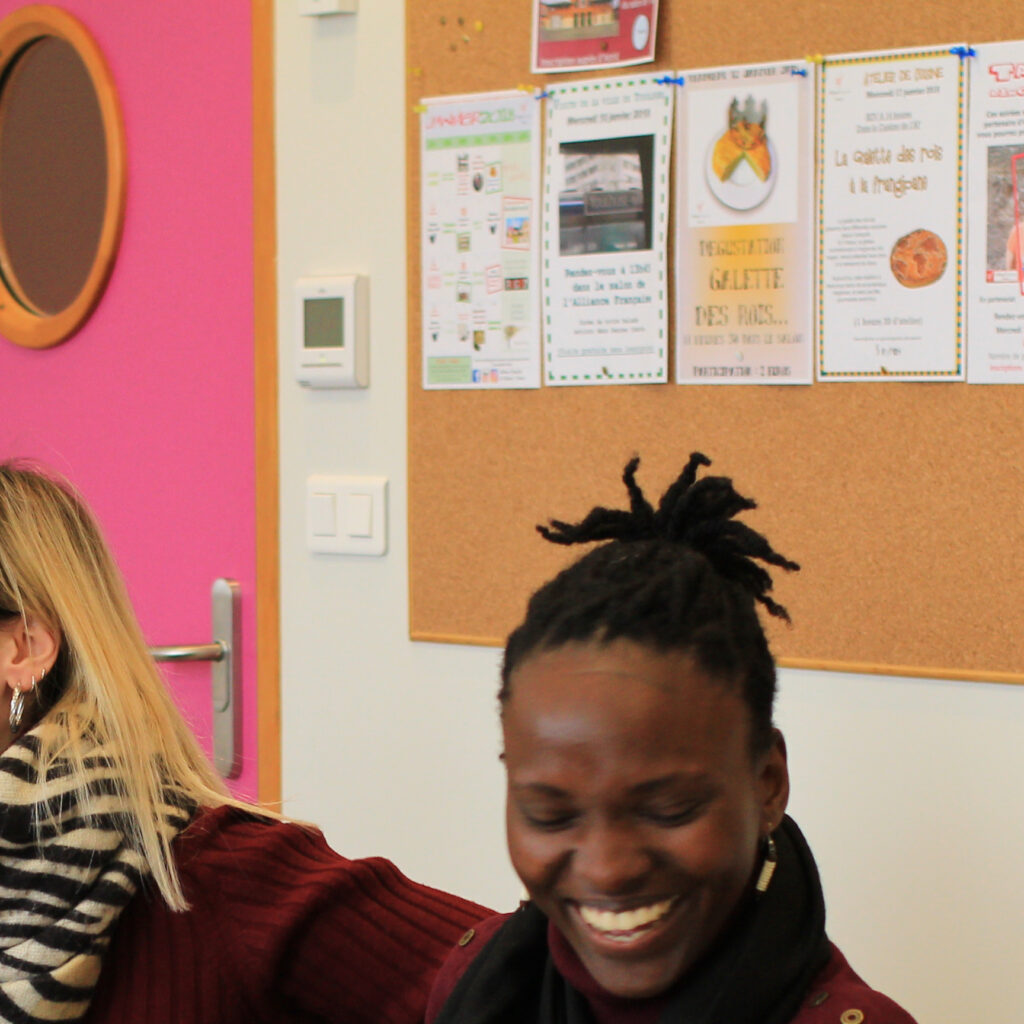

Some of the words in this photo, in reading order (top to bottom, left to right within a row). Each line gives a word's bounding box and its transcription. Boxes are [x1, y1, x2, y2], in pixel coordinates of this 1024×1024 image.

[835, 149, 848, 167] La
[896, 144, 915, 162] des
[709, 267, 784, 290] GALETTE
[695, 304, 728, 327] DES
